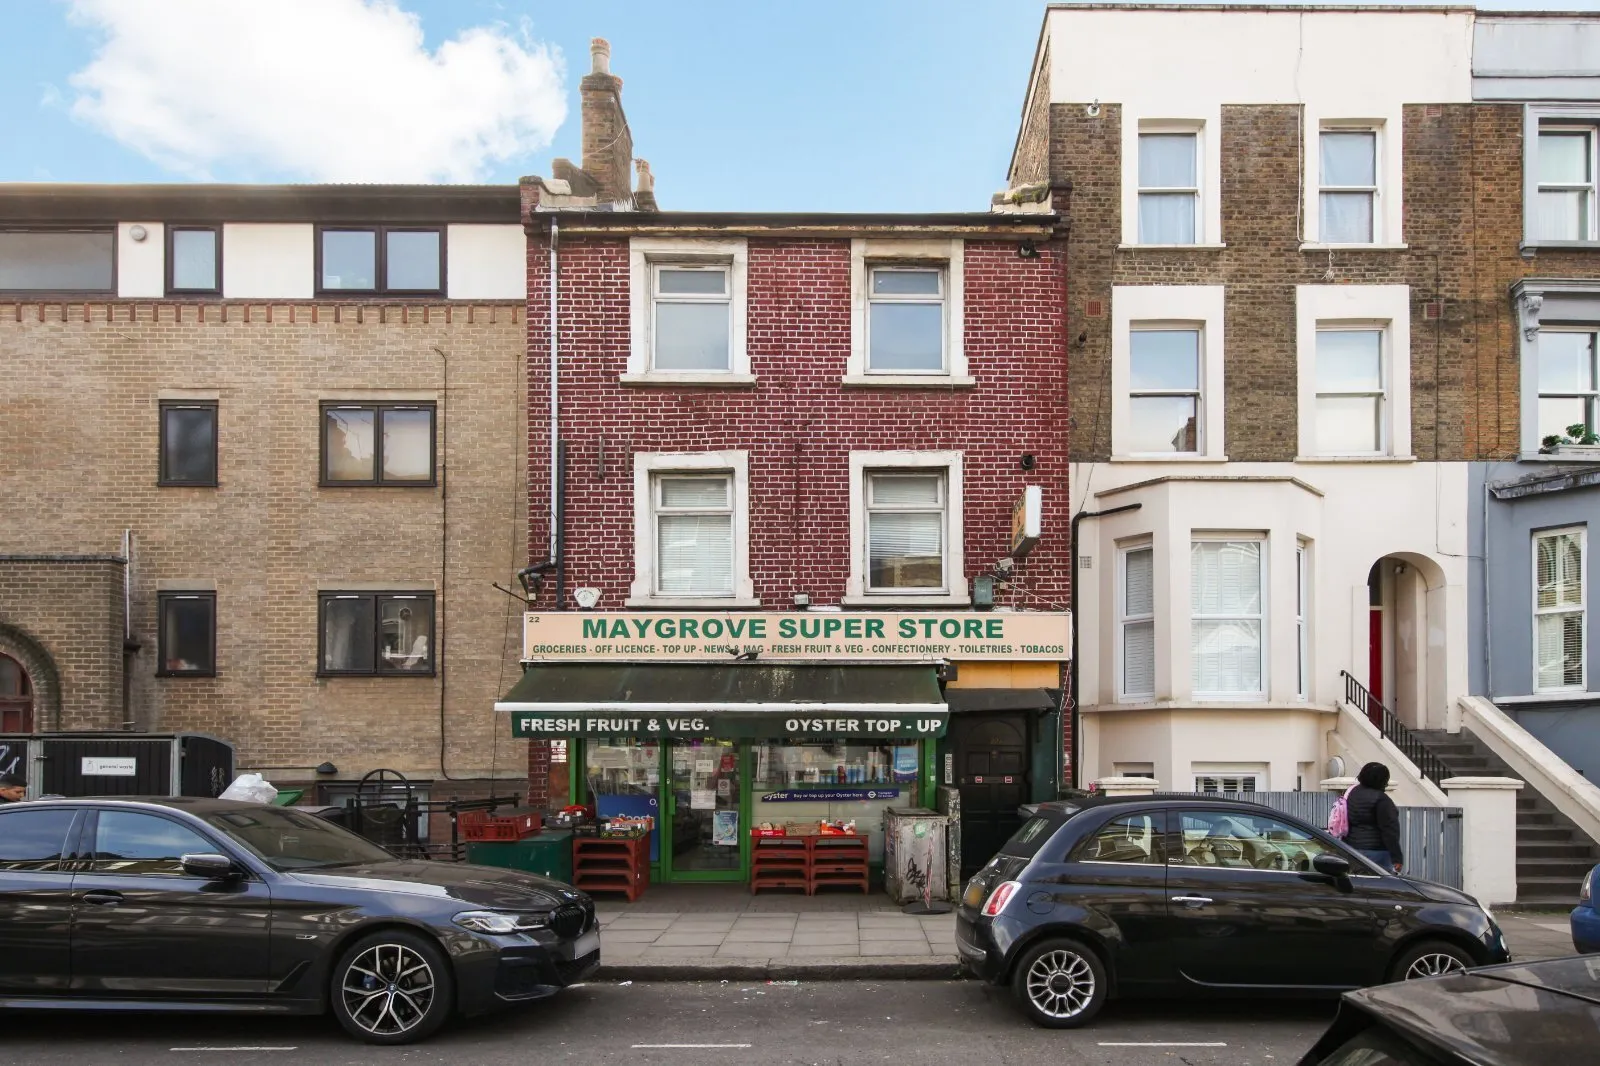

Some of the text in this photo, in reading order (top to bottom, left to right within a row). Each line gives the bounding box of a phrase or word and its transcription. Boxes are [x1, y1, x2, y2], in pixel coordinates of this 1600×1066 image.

[582, 618, 1004, 639] MAYGROVE SUPER STORE
[532, 644, 587, 654] GROCERIES
[594, 644, 613, 654] OFF
[615, 644, 656, 654] LICENCE
[662, 644, 681, 654] TOP
[683, 644, 697, 654] UP
[703, 644, 730, 654] NEWS
[743, 644, 764, 654] MAG
[771, 644, 802, 654] FRESH
[804, 644, 832, 654] FRUIT
[834, 644, 842, 654] &
[844, 644, 864, 654] VEG
[871, 644, 951, 654] CONFECTIONERY
[958, 644, 1013, 654] TOILETRIES
[1020, 644, 1064, 654] TOBACOS
[520, 718, 581, 732] FRESH
[586, 718, 642, 732] FRUIT
[646, 718, 661, 732] &
[666, 718, 710, 732] VEG.
[785, 719, 860, 732] OYSTER
[864, 719, 902, 732] TOP
[916, 719, 942, 733] UP
